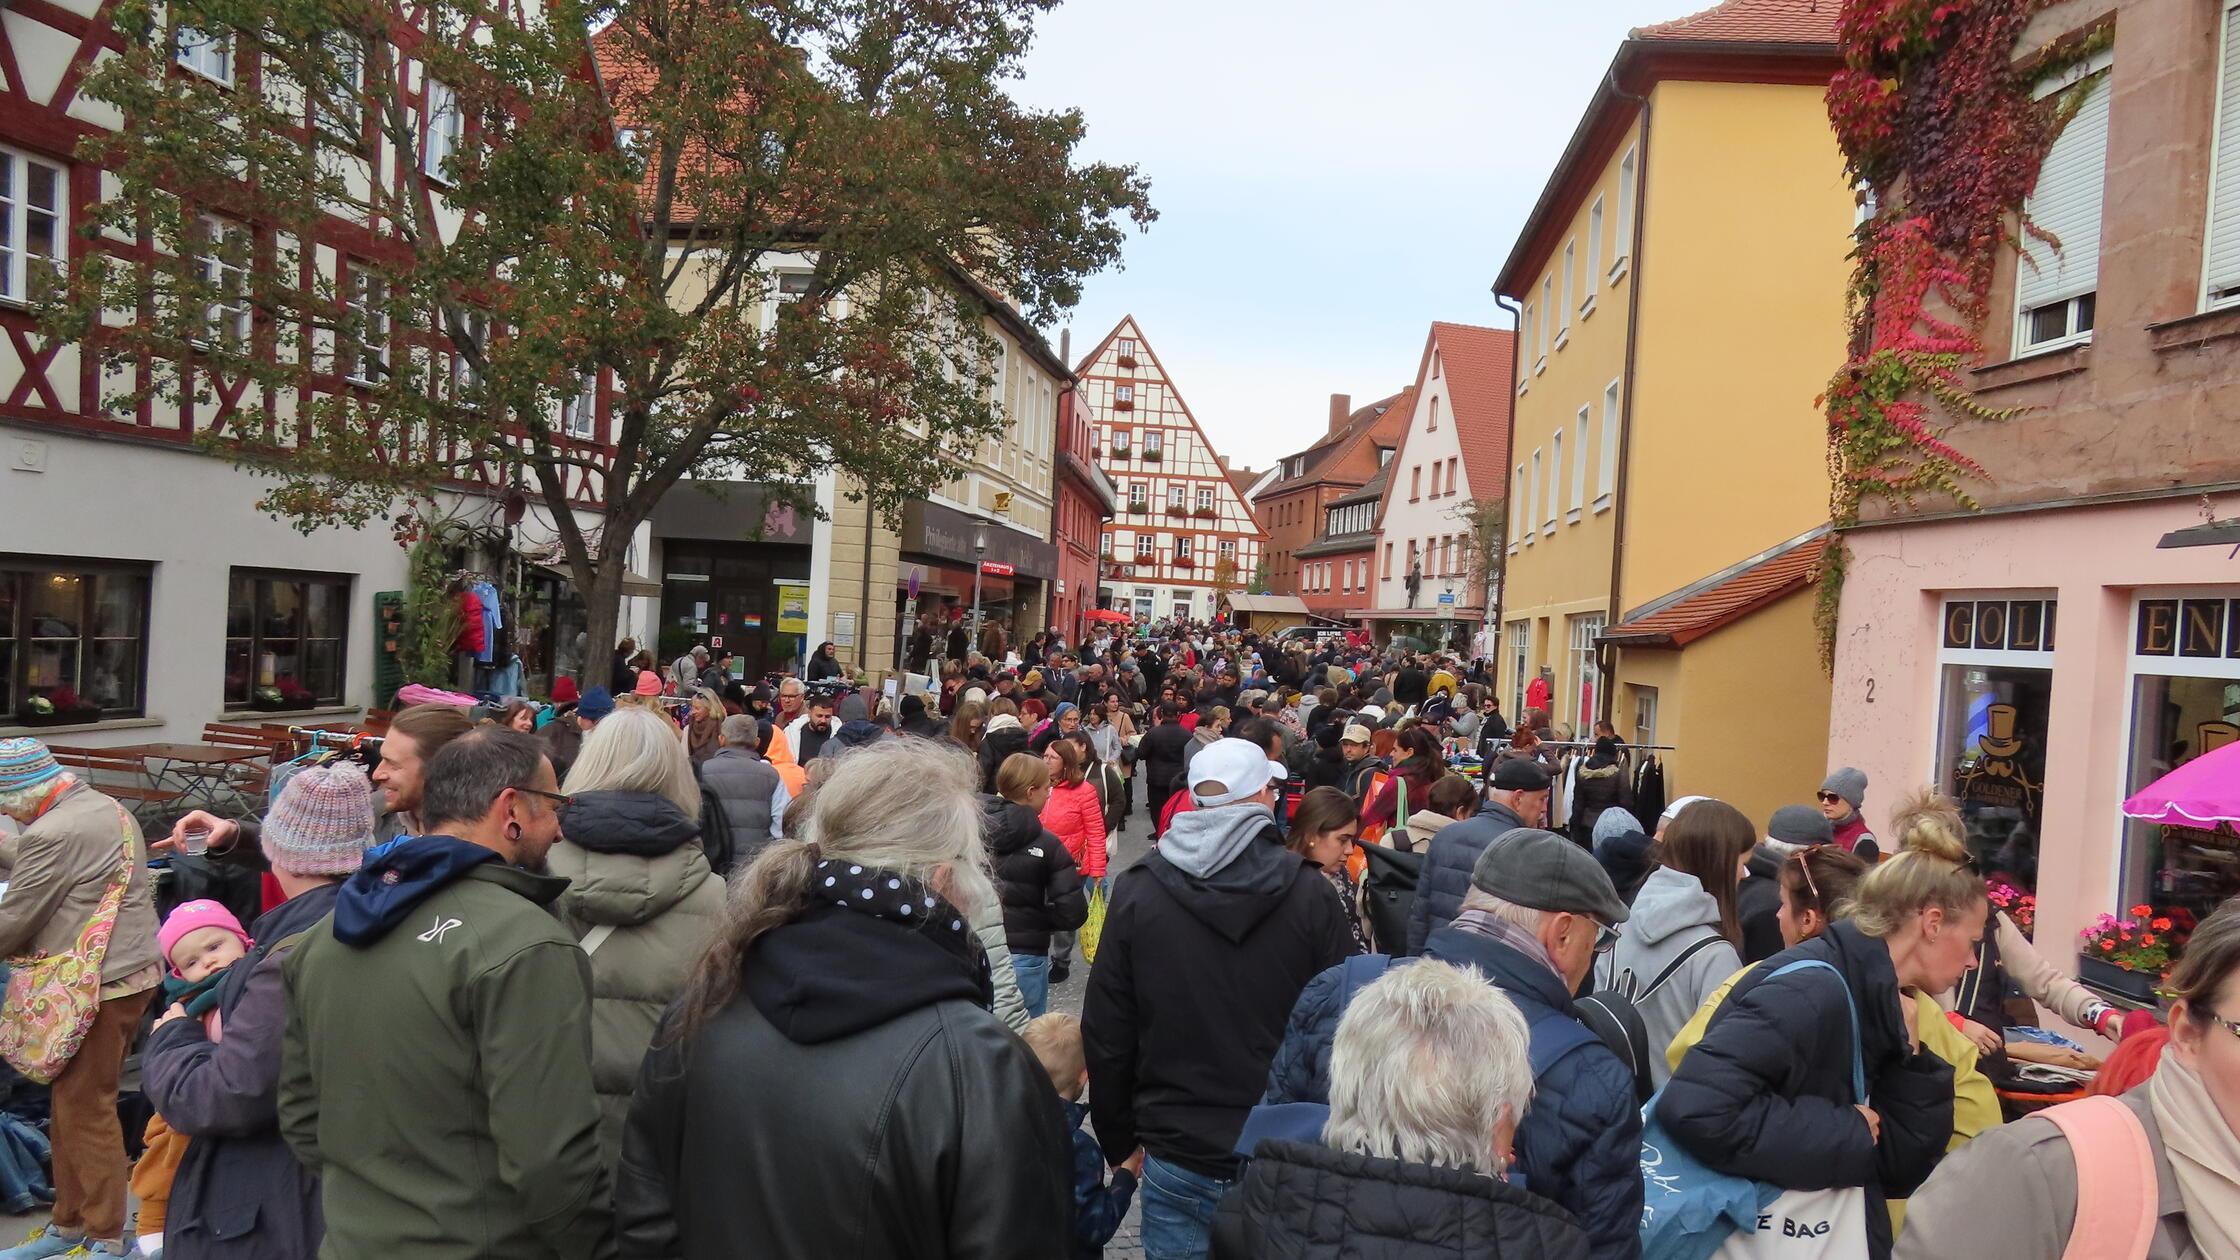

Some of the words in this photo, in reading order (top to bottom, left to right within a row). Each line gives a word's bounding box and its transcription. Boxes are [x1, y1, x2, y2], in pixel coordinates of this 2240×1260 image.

[2144, 604, 2240, 653] EN
[1865, 677, 1876, 704] 2
[1782, 1216, 1832, 1239] BAG
